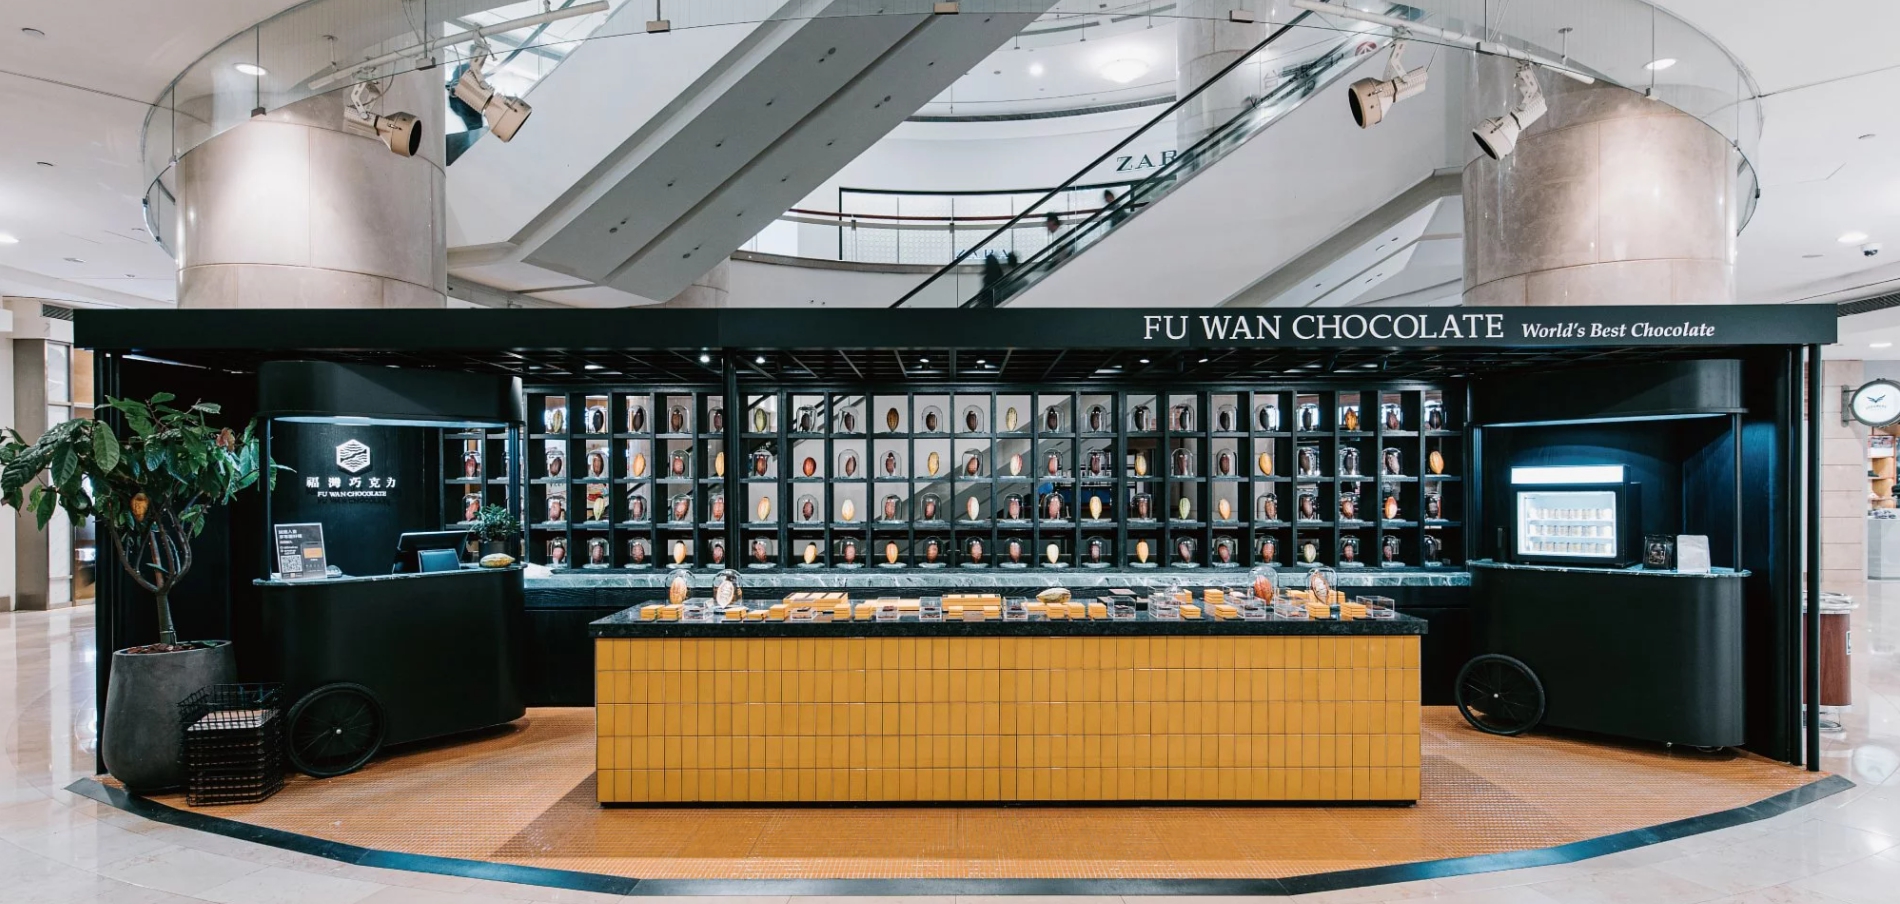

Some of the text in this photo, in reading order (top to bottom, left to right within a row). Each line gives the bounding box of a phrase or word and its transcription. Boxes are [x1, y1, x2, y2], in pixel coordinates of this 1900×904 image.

[1144, 313, 1504, 340] FU WAN CHOCOLATE
[1521, 321, 1716, 338] World’s Best Chocolate
[347, 490, 387, 498] CHOCOLATE
